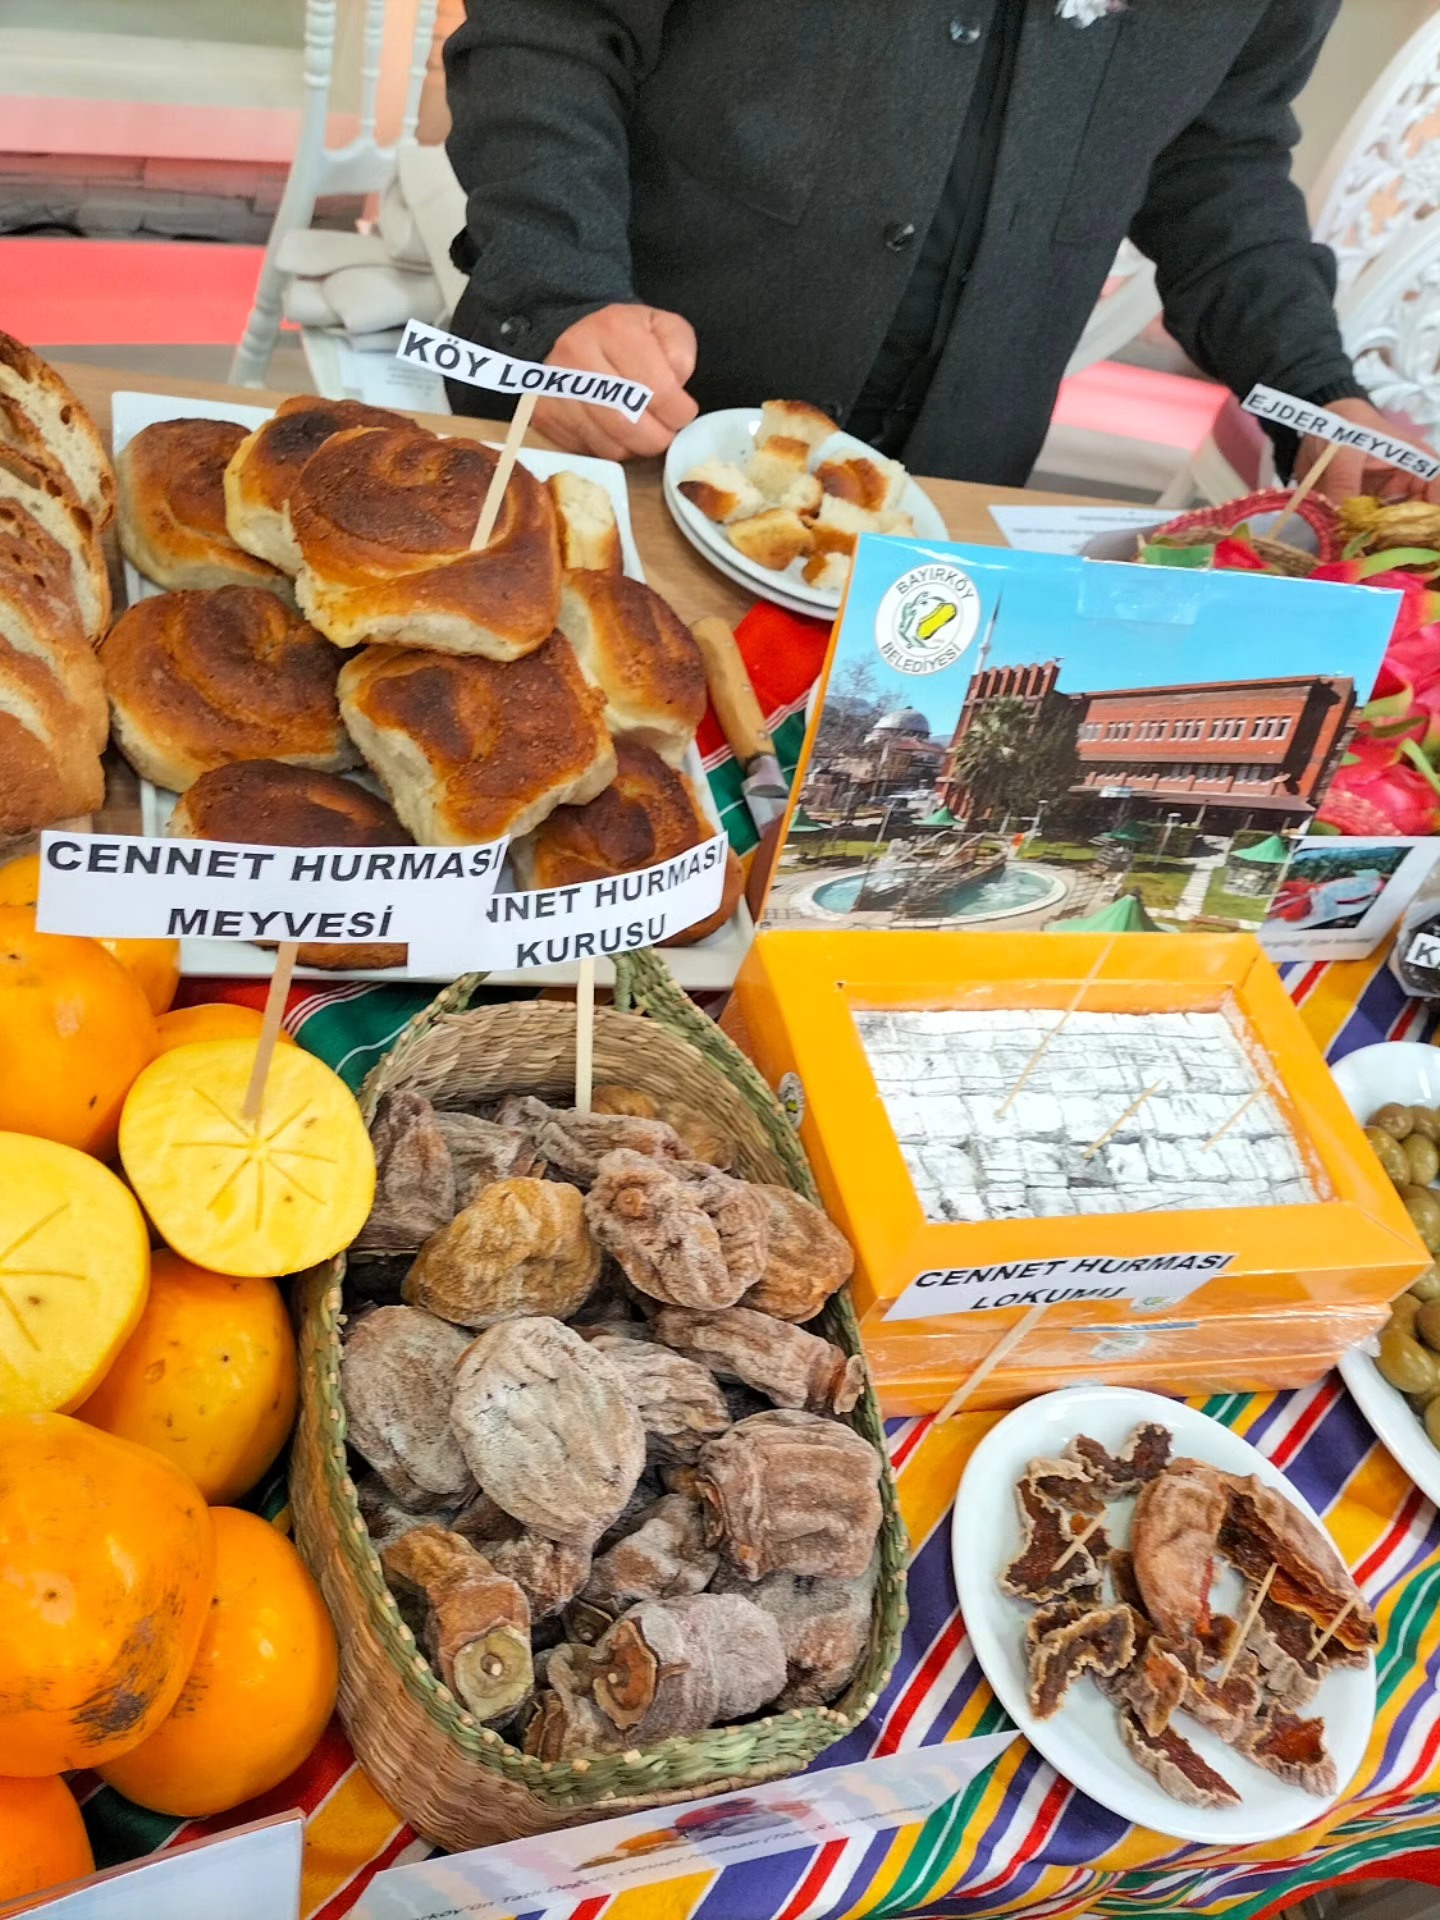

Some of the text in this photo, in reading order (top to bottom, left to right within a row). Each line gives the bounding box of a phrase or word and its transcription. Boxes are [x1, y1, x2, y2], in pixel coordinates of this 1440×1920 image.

[403, 331, 490, 378] KÖY
[498, 364, 648, 412] LOKUMU
[1247, 393, 1328, 433] EJDER
[896, 567, 975, 599] BAYIRKÖY
[47, 841, 503, 882] CENNET HURMASI
[594, 840, 724, 908] HURMASI
[167, 905, 394, 938] MEYVESİ
[516, 913, 667, 969] KURUSU
[914, 1254, 1234, 1288] CENNET HURMASI
[970, 1287, 1127, 1311] LOKUMU
